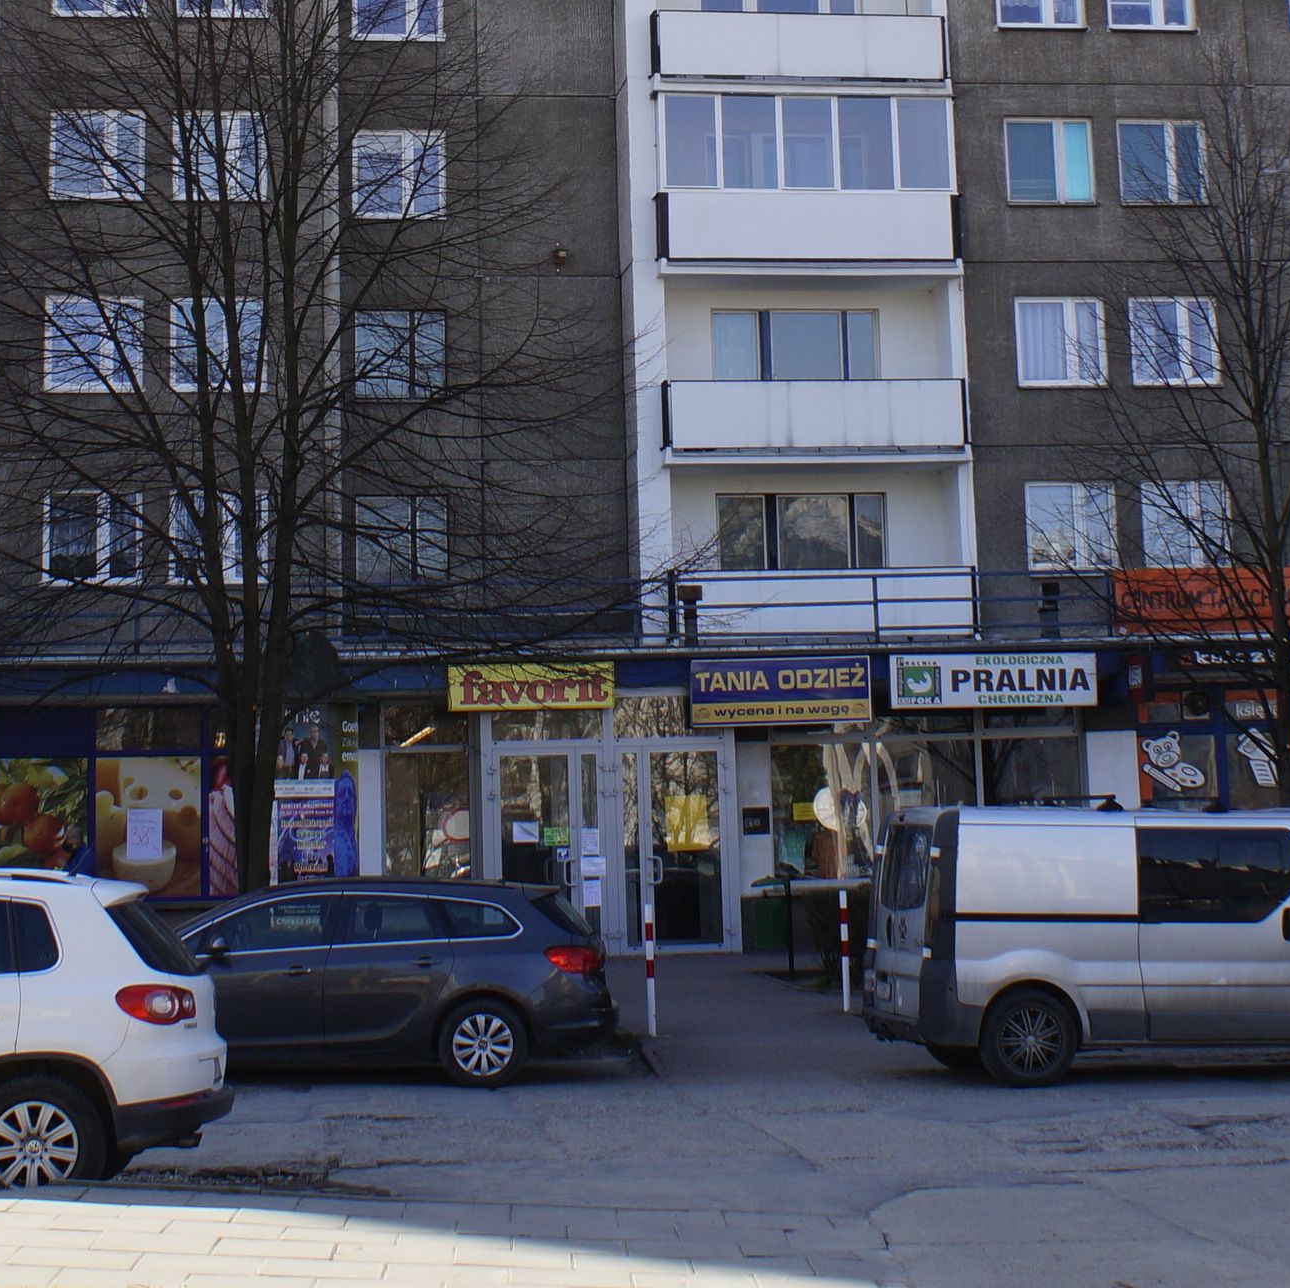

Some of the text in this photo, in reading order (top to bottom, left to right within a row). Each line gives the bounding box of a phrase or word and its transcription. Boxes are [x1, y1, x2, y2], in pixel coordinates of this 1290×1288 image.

[1121, 589, 1201, 611] CENTRUM
[975, 656, 1064, 665] EKOLOGICZNA
[460, 669, 609, 706] favorit
[696, 669, 769, 693] TANIA
[778, 662, 866, 691] ODZIEŻ
[950, 668, 1090, 692] PRALNIA
[978, 694, 1064, 704] CHEMICZNA
[714, 704, 850, 718] wycena i na wagę
